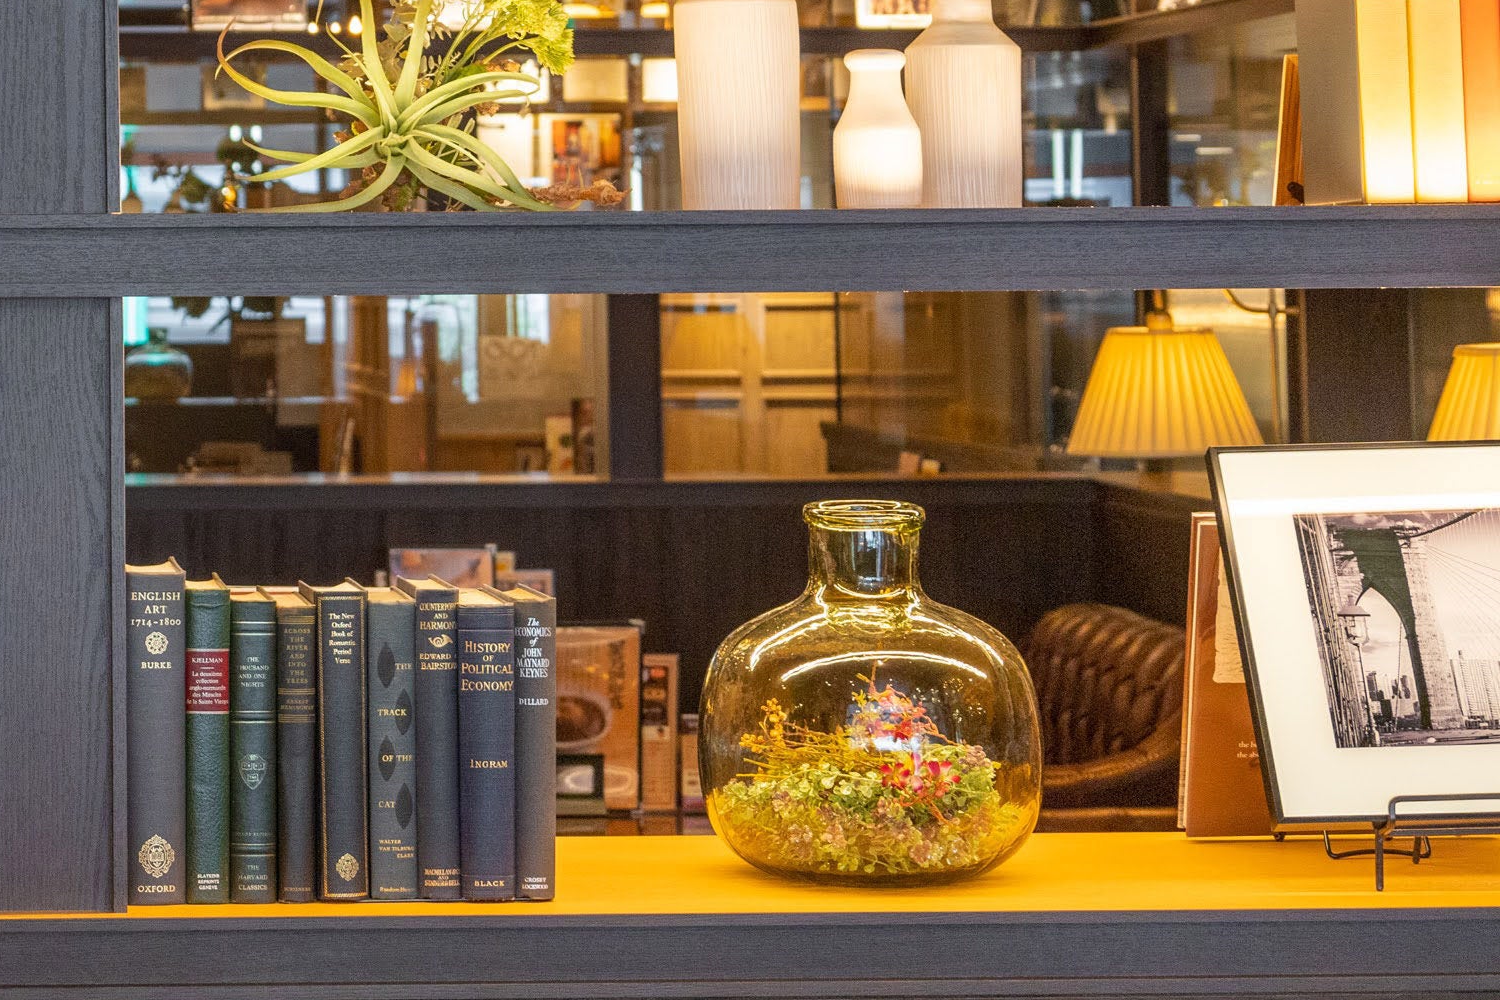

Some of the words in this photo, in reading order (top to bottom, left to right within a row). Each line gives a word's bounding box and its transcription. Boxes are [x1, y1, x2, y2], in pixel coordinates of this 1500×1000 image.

[131, 592, 180, 600] ENGLISH
[144, 605, 168, 614] ART
[419, 602, 457, 611] COUNTERPOI
[131, 618, 181, 627] 1714-1800
[527, 617, 540, 626] The
[514, 626, 552, 637] ECONOMICS
[465, 640, 511, 653] HISTORY
[529, 637, 539, 647] of
[521, 647, 542, 658] JOHN
[516, 657, 550, 668] MAYNARD
[461, 663, 513, 674] POLITICAL
[519, 668, 548, 678] KEYNES
[461, 679, 514, 691] ECONOMY
[519, 697, 549, 706] DILLARD
[381, 754, 394, 762] OF
[470, 759, 508, 768] INGRAM
[137, 885, 176, 893] OXFORD
